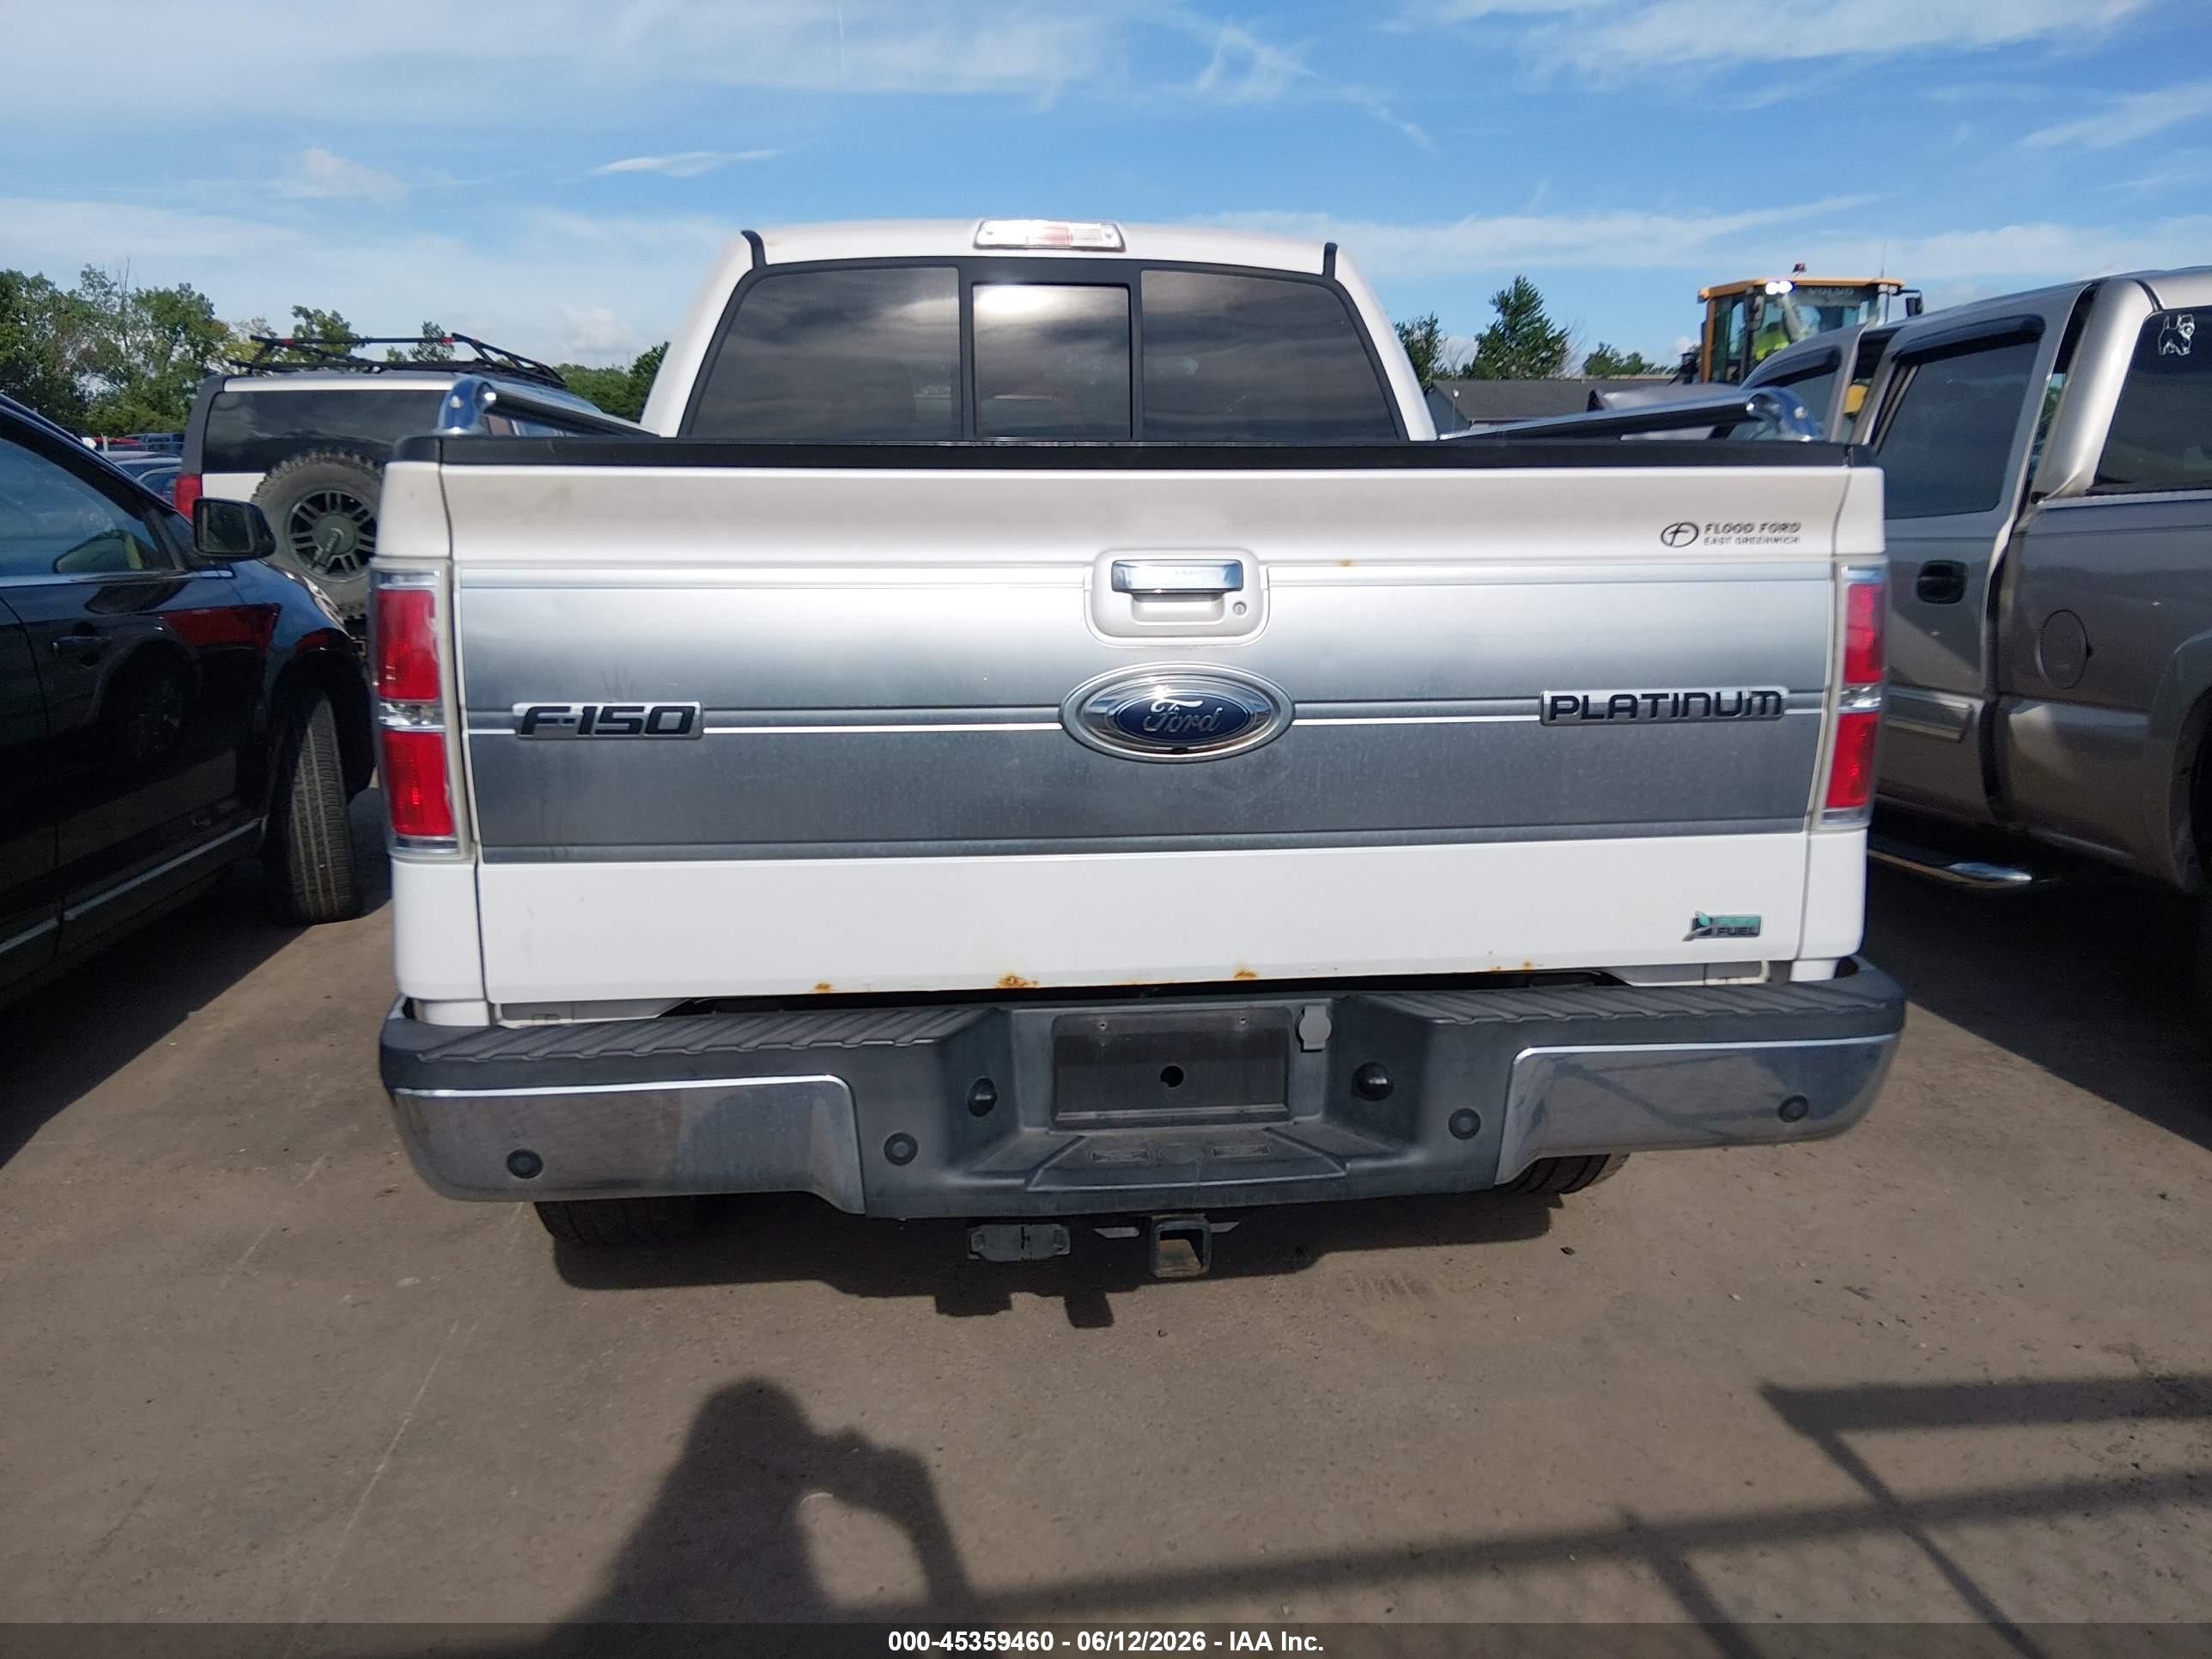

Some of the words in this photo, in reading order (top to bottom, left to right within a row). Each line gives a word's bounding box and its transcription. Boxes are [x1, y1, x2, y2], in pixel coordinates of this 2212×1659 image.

[1704, 521, 1755, 535] FLOOD
[1759, 521, 1802, 535] FORD
[1703, 536, 1730, 546] EAST
[1142, 697, 1224, 733] Ford
[1548, 690, 1783, 720] PLATINUM
[520, 705, 696, 736] F-150
[1717, 926, 1759, 937] FUEL
